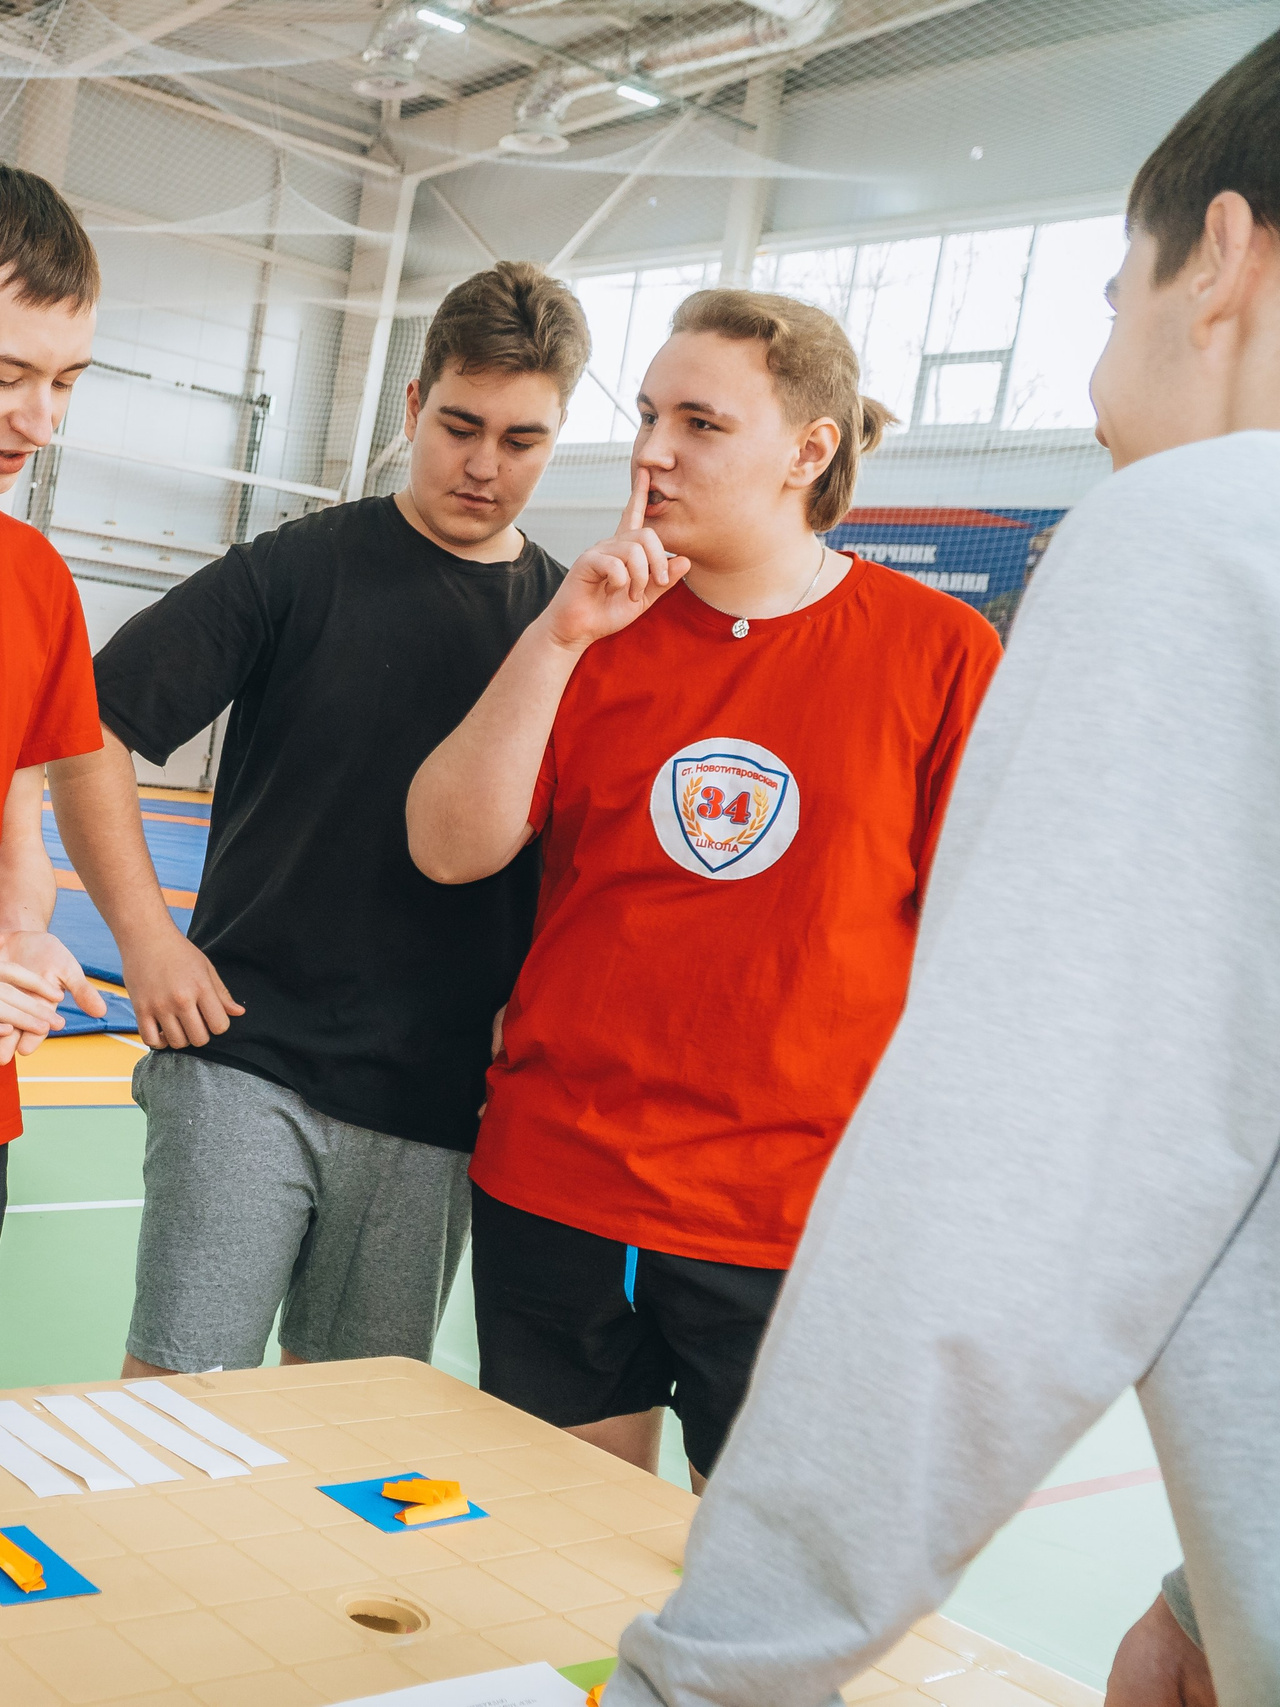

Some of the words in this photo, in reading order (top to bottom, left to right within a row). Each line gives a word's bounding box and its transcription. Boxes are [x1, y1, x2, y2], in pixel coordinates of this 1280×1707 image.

[681, 766, 694, 777] ст.
[695, 763, 778, 790] Новотитаровская
[696, 786, 751, 825] 34
[695, 838, 740, 854] ШКОЛА
